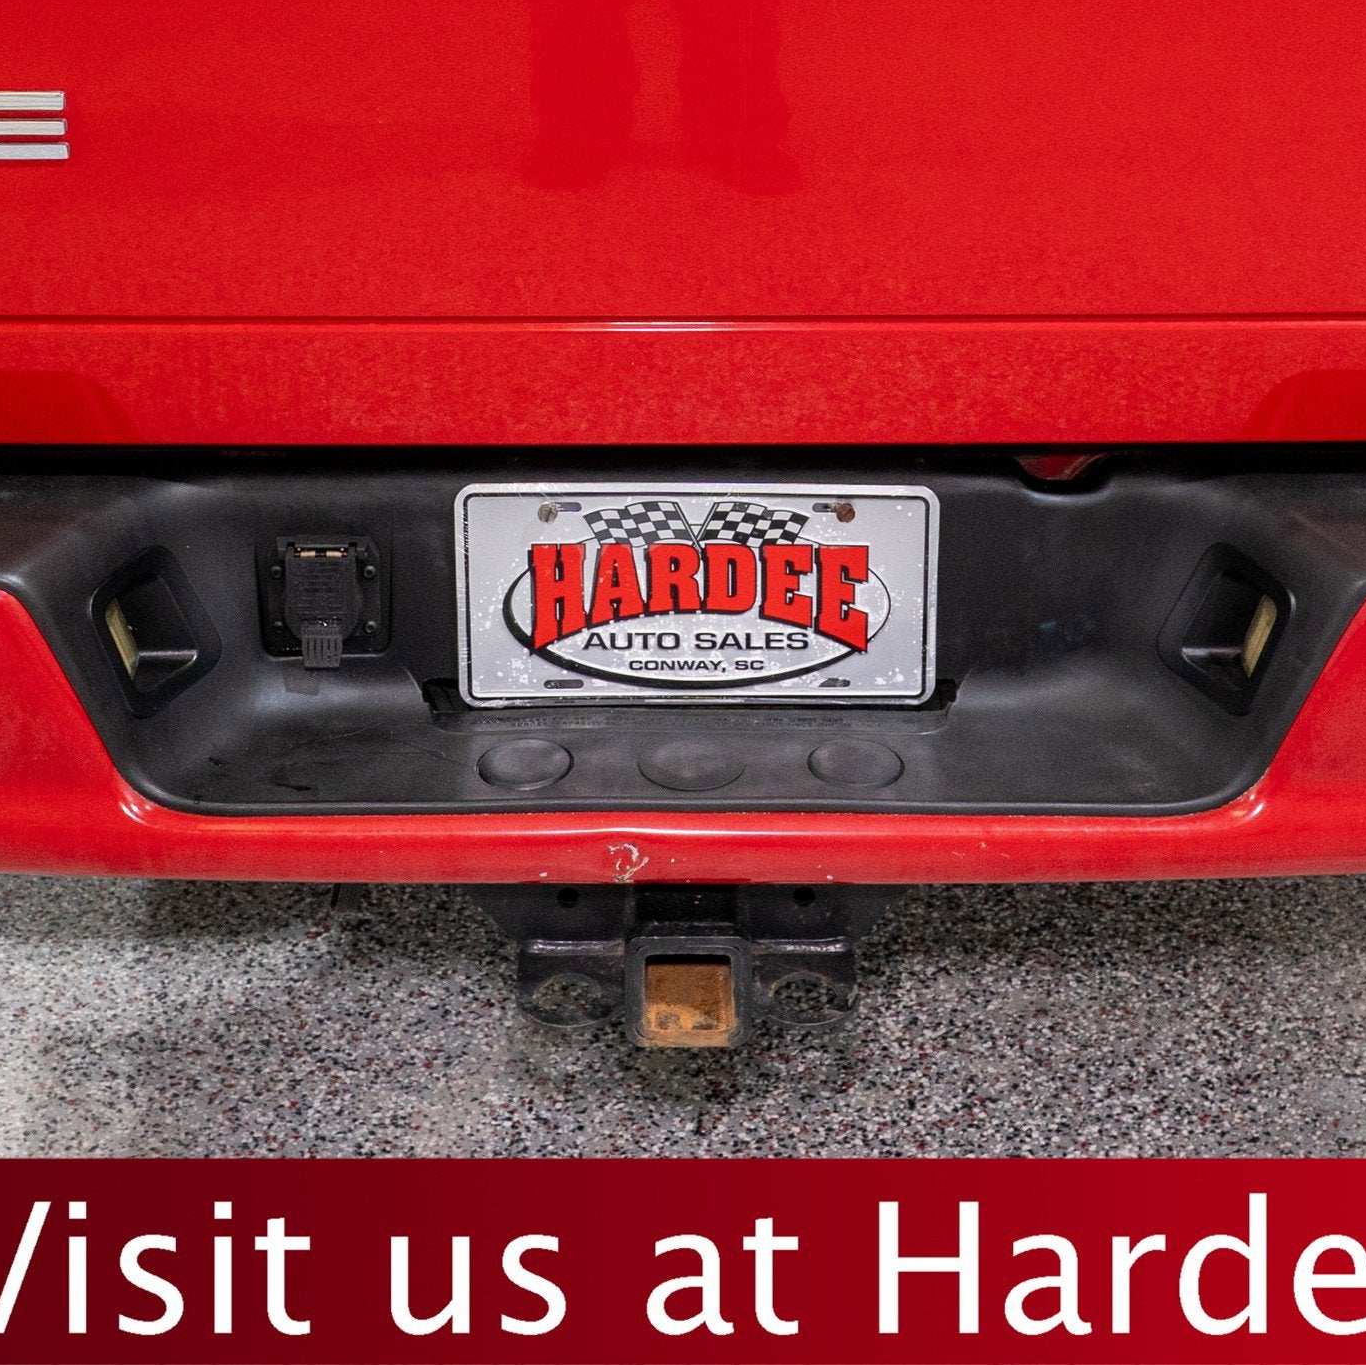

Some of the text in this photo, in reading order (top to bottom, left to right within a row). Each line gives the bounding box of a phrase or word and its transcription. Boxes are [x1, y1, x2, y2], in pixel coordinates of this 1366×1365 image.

[528, 543, 870, 655] HARDEE
[582, 631, 809, 651] AUTO SALES
[628, 659, 765, 673] CONWAY, SC
